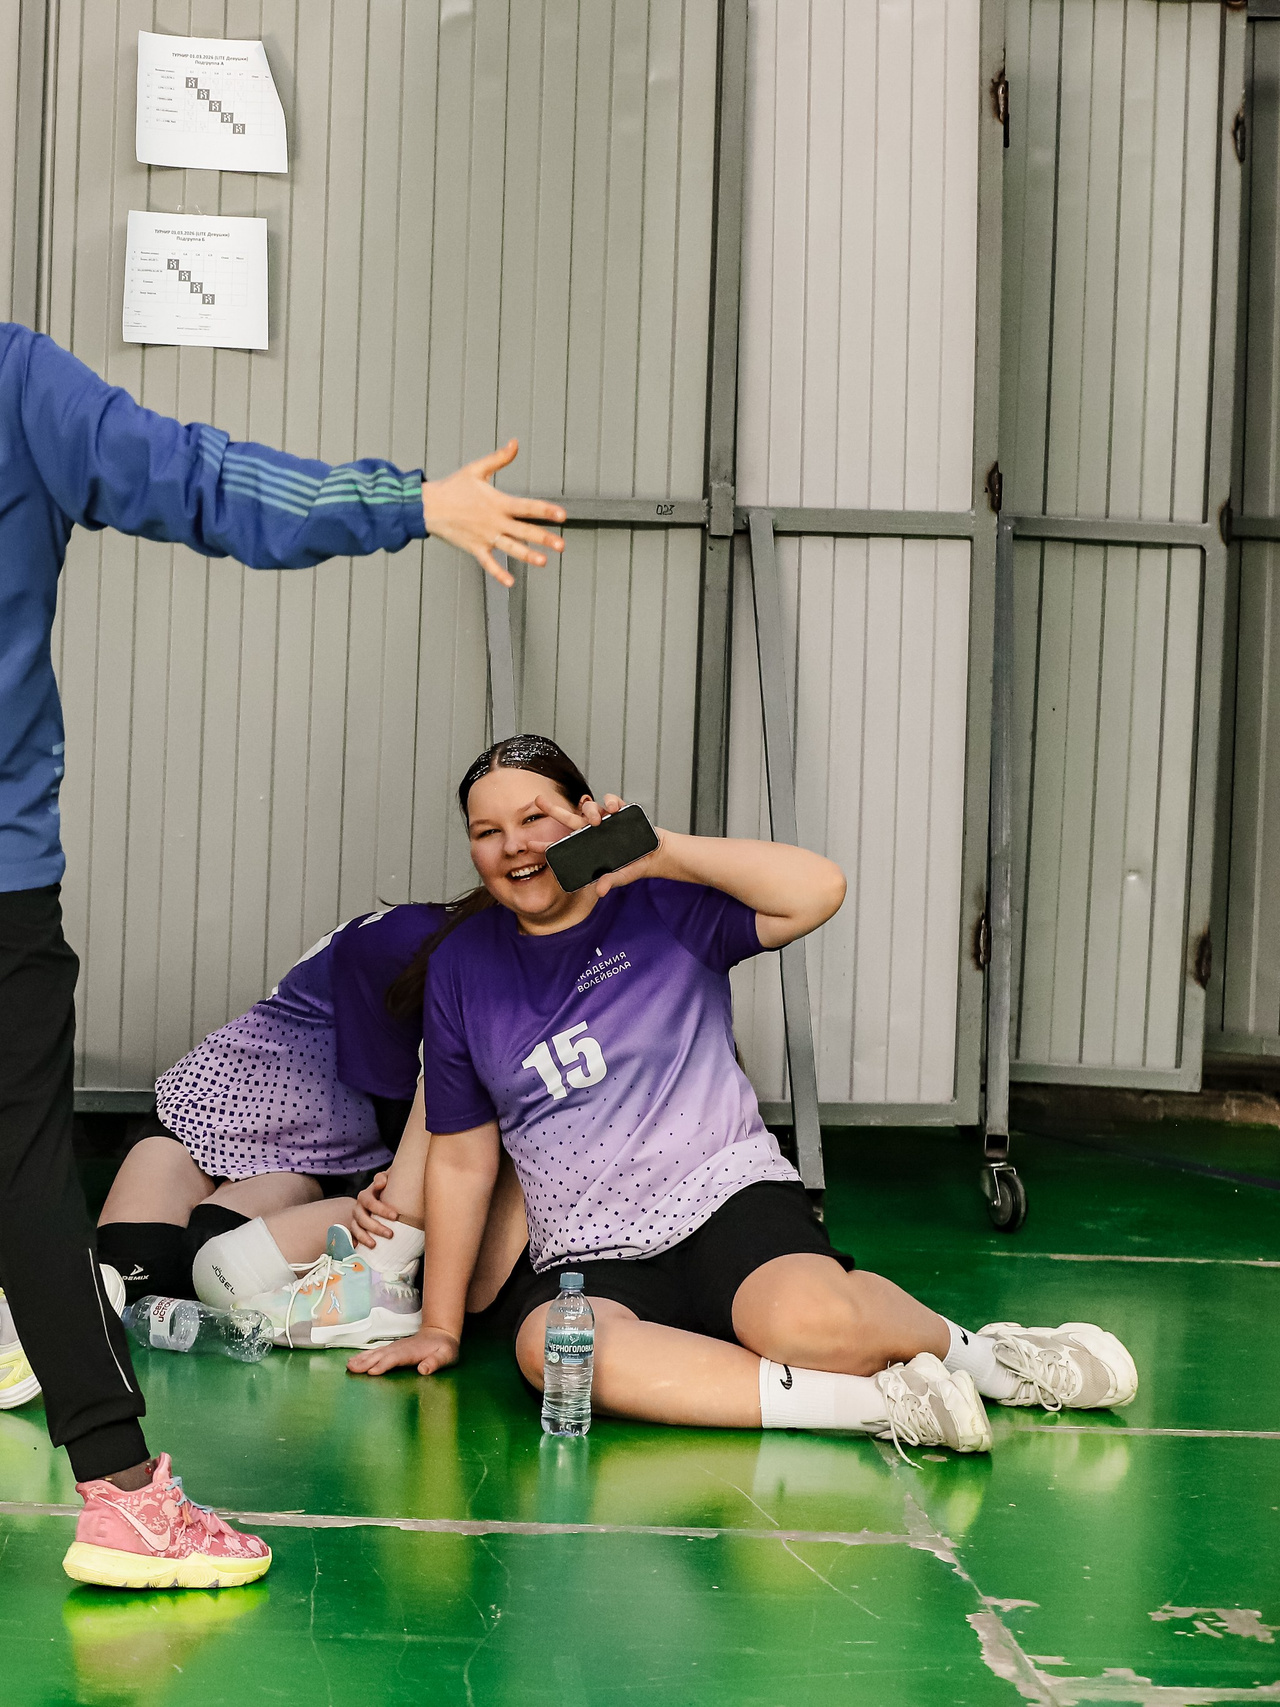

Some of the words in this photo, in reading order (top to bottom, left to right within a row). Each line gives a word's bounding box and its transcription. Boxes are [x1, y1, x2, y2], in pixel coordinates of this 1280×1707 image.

[577, 951, 626, 982] КАДЕМИЯ
[577, 961, 632, 993] ВОЛЕЙБОЛА
[521, 1020, 608, 1101] 15
[211, 1264, 236, 1296] JÖGEL
